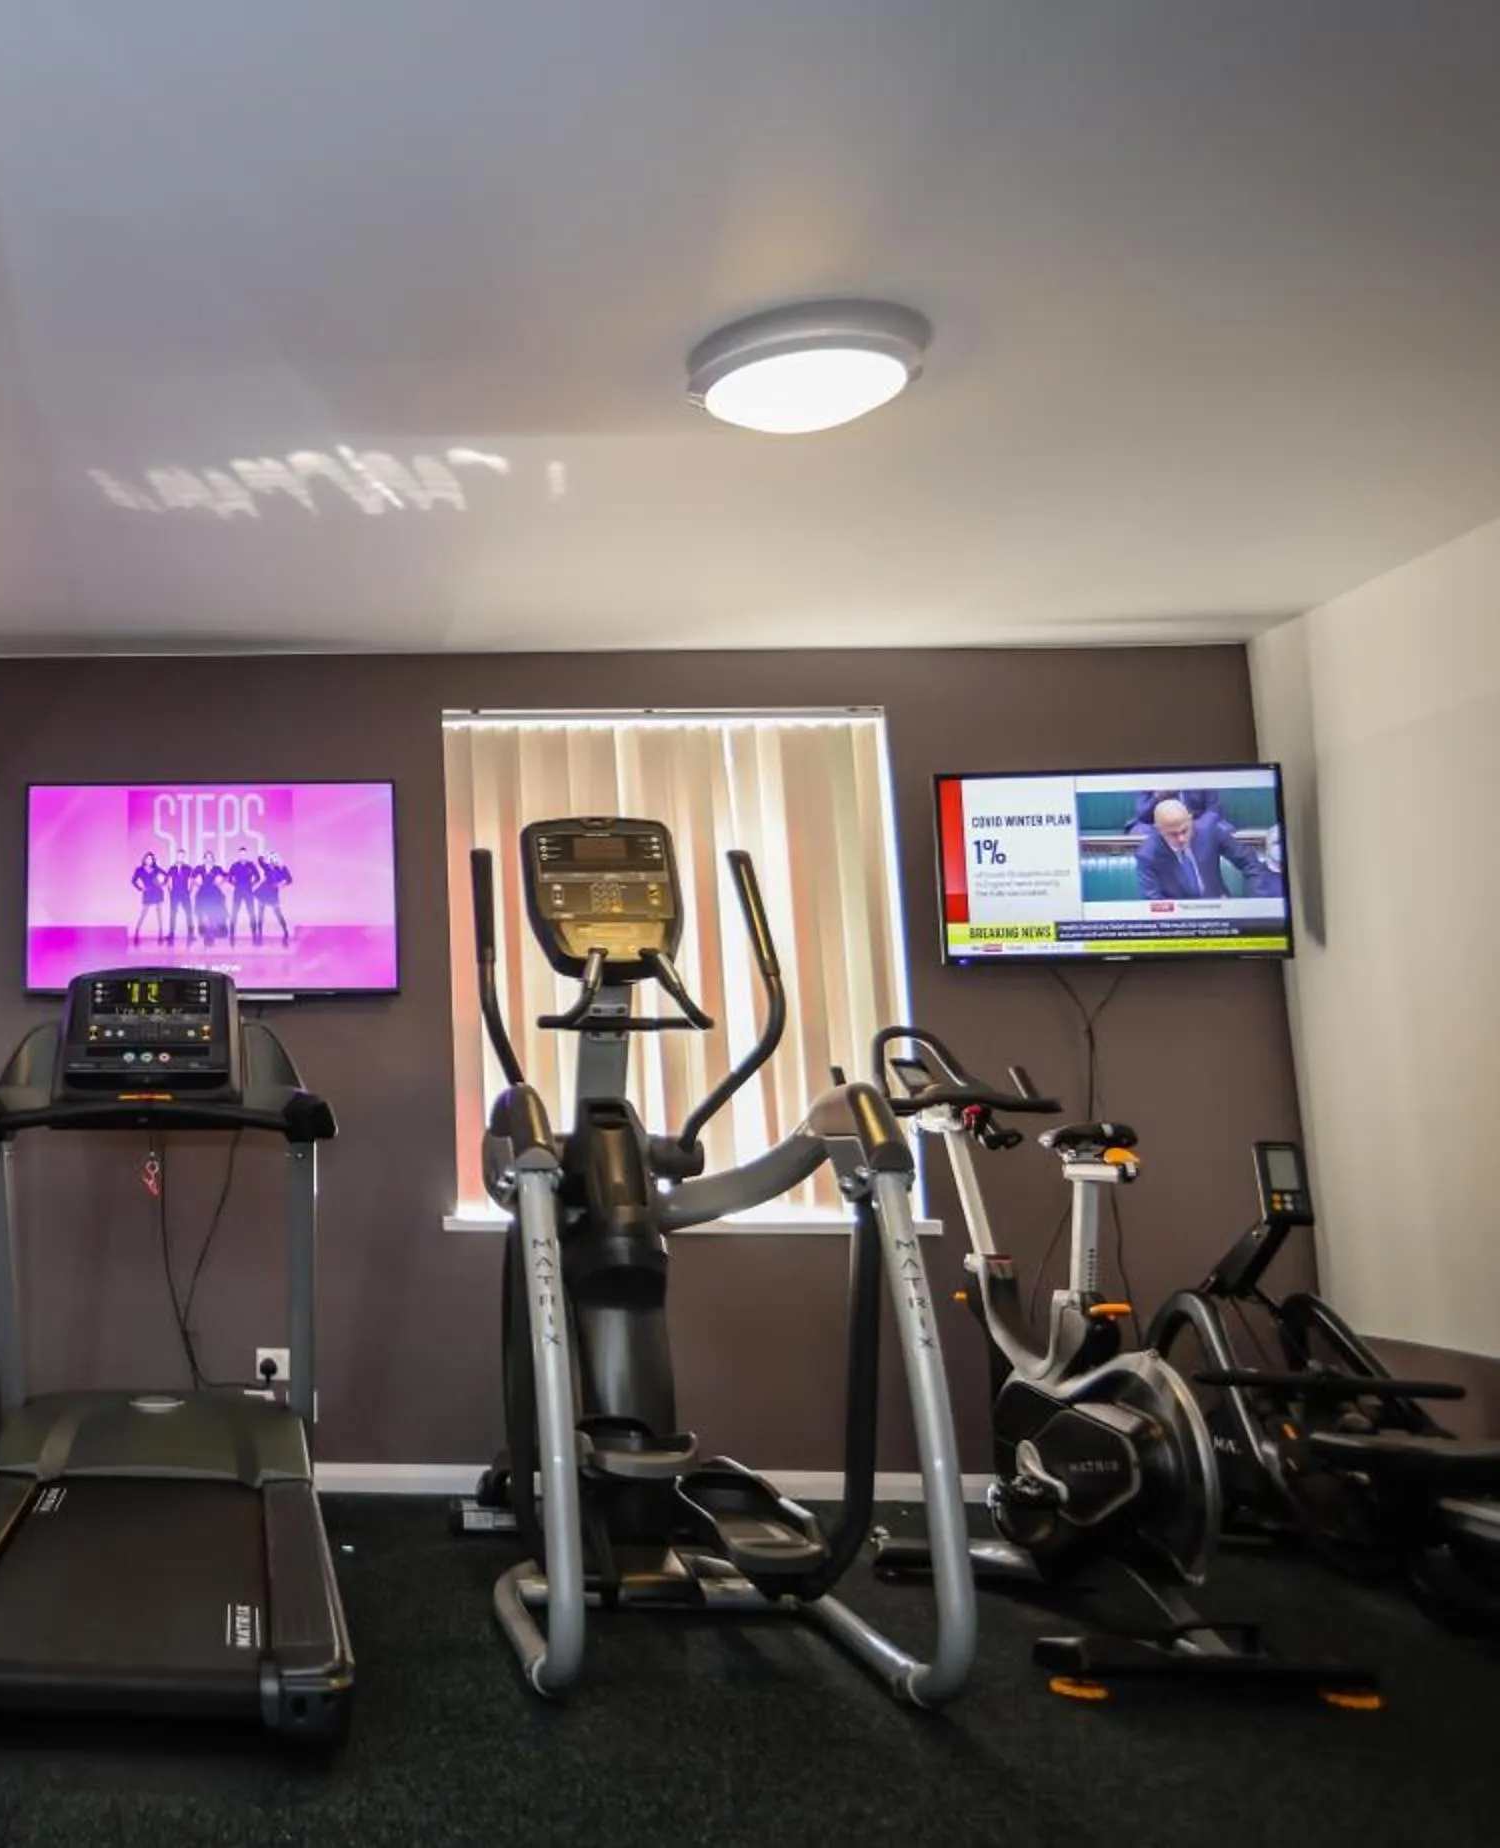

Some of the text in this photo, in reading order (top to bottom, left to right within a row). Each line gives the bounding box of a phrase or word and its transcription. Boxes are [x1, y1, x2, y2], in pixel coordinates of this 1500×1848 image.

[153, 793, 265, 867] STEPS
[972, 814, 1071, 828] COVID WINTER PLAN
[974, 839, 1006, 864] 1%
[969, 926, 1019, 938] BREAKING
[1022, 926, 1051, 938] NEWS
[532, 1238, 561, 1346] MATRIX
[895, 1239, 934, 1348] MATRIX
